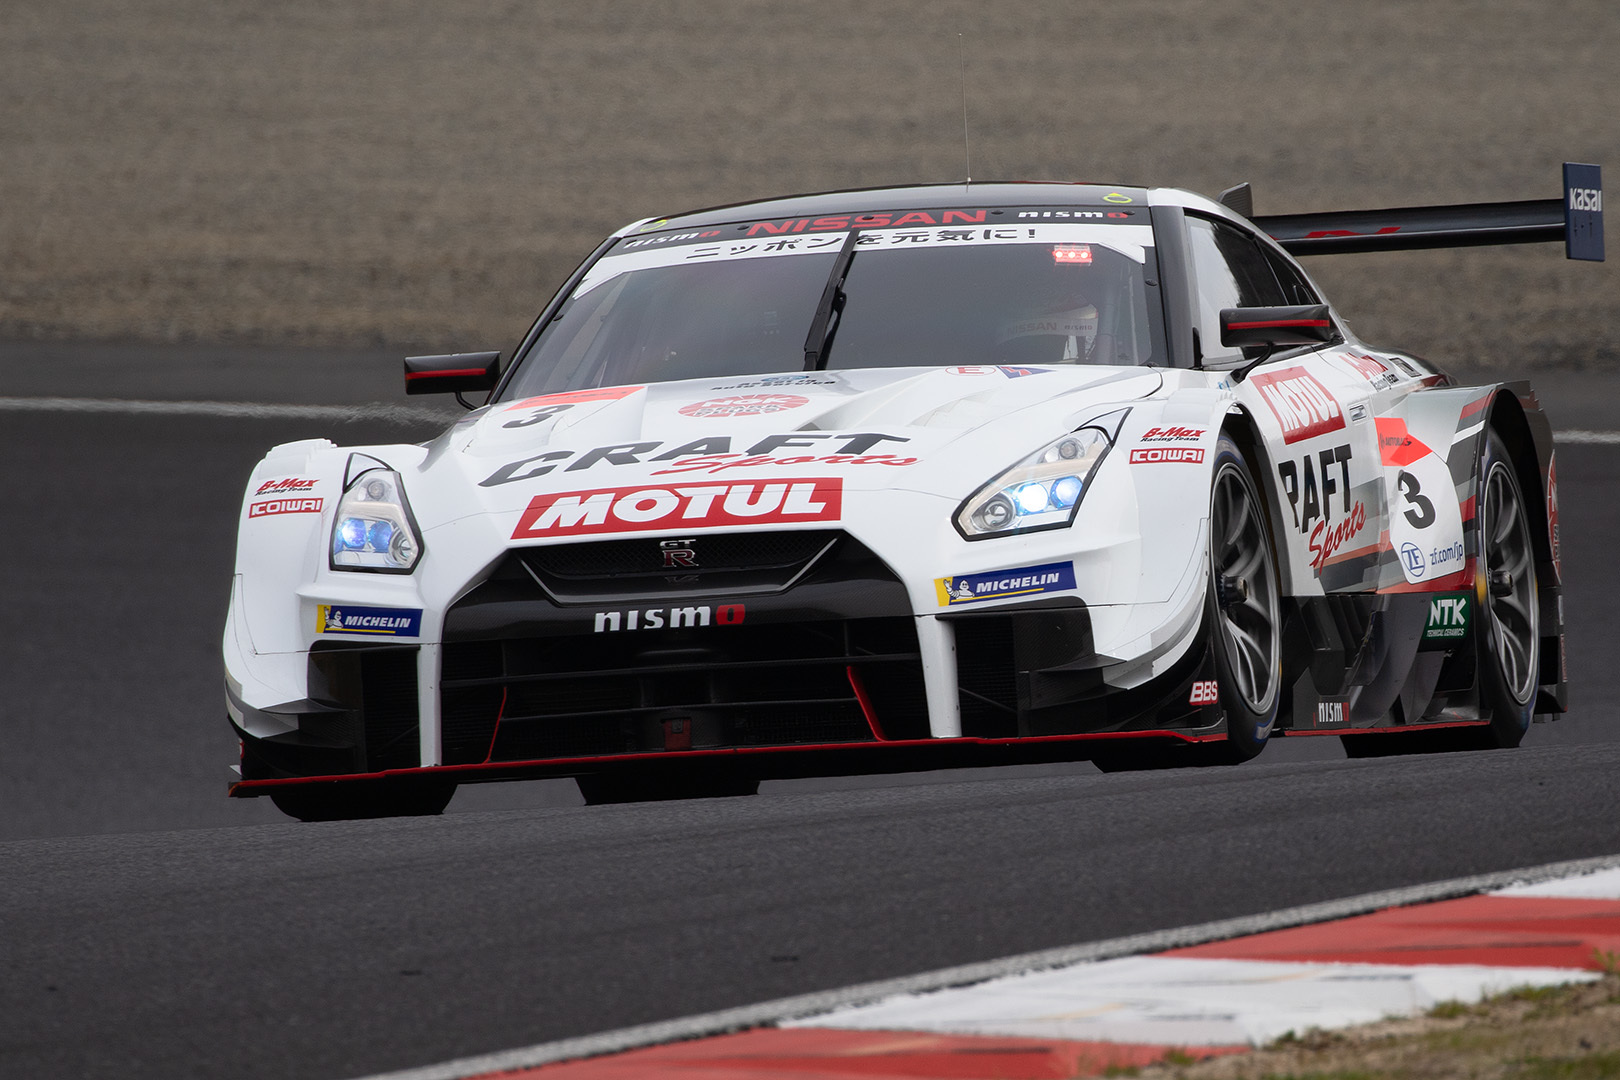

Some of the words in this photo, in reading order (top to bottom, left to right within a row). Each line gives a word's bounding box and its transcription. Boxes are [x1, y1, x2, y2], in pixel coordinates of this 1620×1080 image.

[746, 210, 987, 236] NISSAN
[1018, 211, 1128, 219] nismo
[624, 230, 721, 249] nismo
[1262, 376, 1339, 432] MOTUL
[502, 404, 575, 429] 3
[1142, 427, 1207, 438] B-Max
[478, 432, 911, 487] CRAFT
[650, 453, 924, 476] Sports
[257, 478, 320, 492] B-Max
[528, 483, 826, 531] MOTUL
[1398, 469, 1436, 530] 3
[659, 539, 697, 548] GT
[1309, 500, 1367, 576] Sports
[662, 549, 699, 567] R
[1429, 541, 1464, 566] zf.com/jp
[976, 572, 1060, 593] MICHELIN
[345, 615, 412, 628] MICHELIN
[594, 604, 745, 632] nismo
[1428, 597, 1467, 627] NTK
[1190, 681, 1218, 702] BBS
[1318, 702, 1349, 723] nismo
